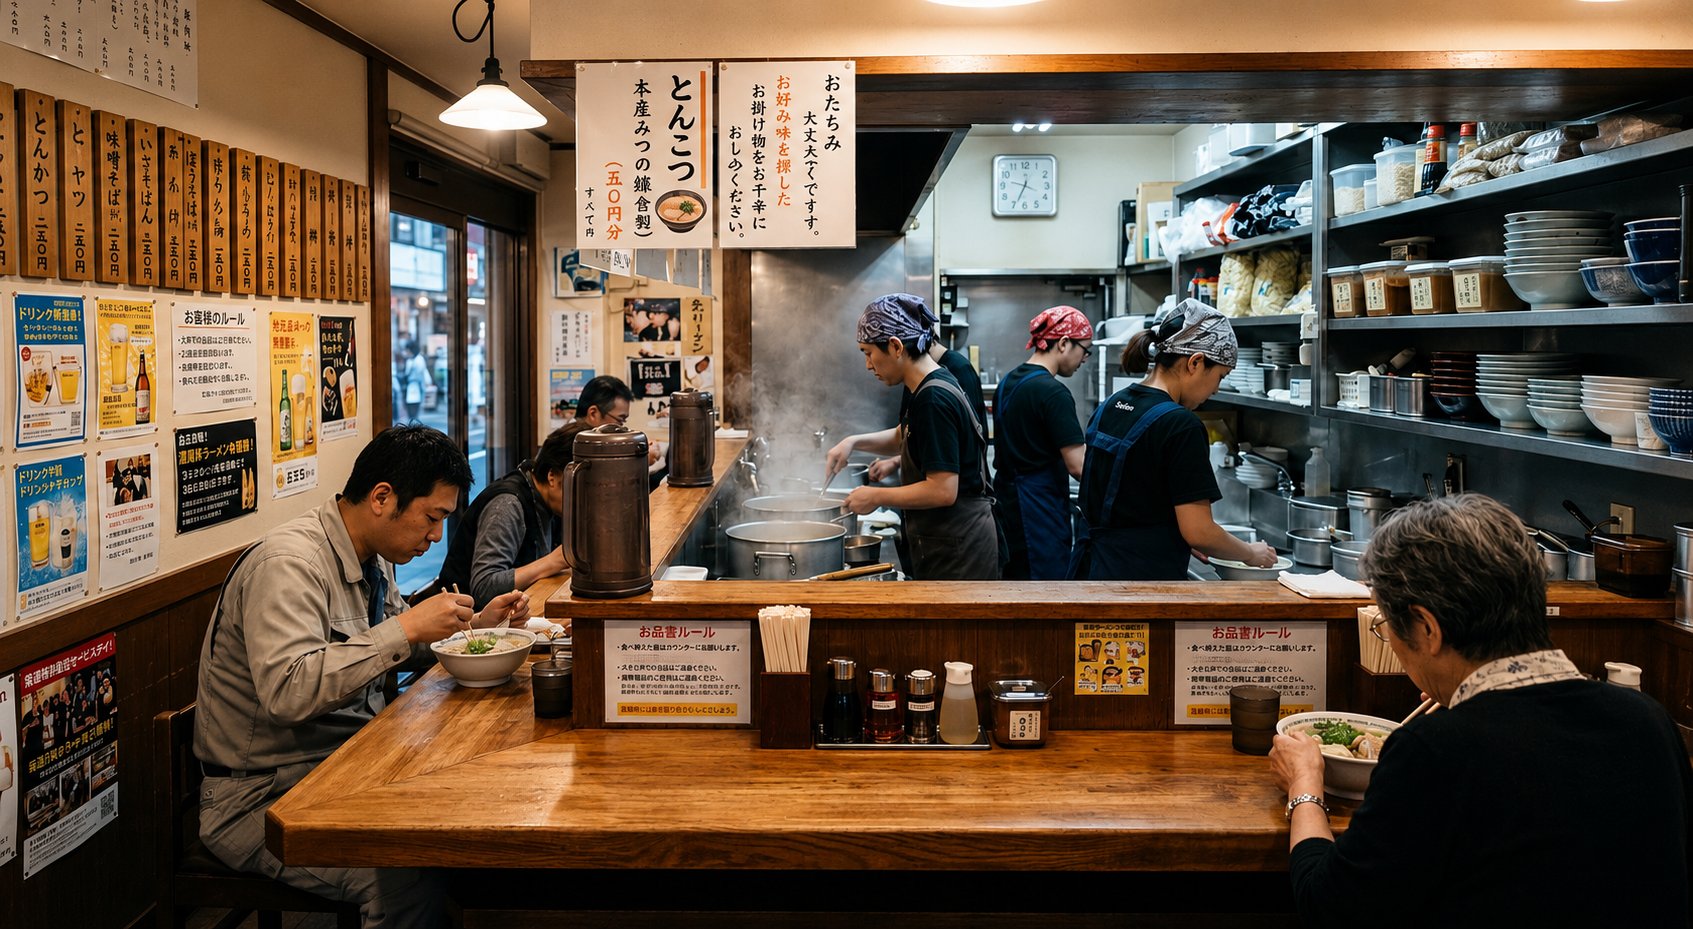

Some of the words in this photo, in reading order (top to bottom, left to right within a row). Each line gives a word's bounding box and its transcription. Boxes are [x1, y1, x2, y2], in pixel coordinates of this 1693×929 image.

[824, 74, 842, 151] おたちみ
[667, 75, 695, 182] とんこつ
[33, 111, 49, 205] とんかつ
[1021, 161, 1030, 170] 12
[1001, 171, 1010, 179] 10
[1042, 170, 1048, 178] 2
[1000, 181, 1006, 190] 9
[1044, 182, 1050, 190] 3
[1001, 193, 1008, 201] 8
[1011, 201, 1017, 209] 7
[1022, 201, 1028, 210] 6
[1034, 200, 1039, 208] 5
